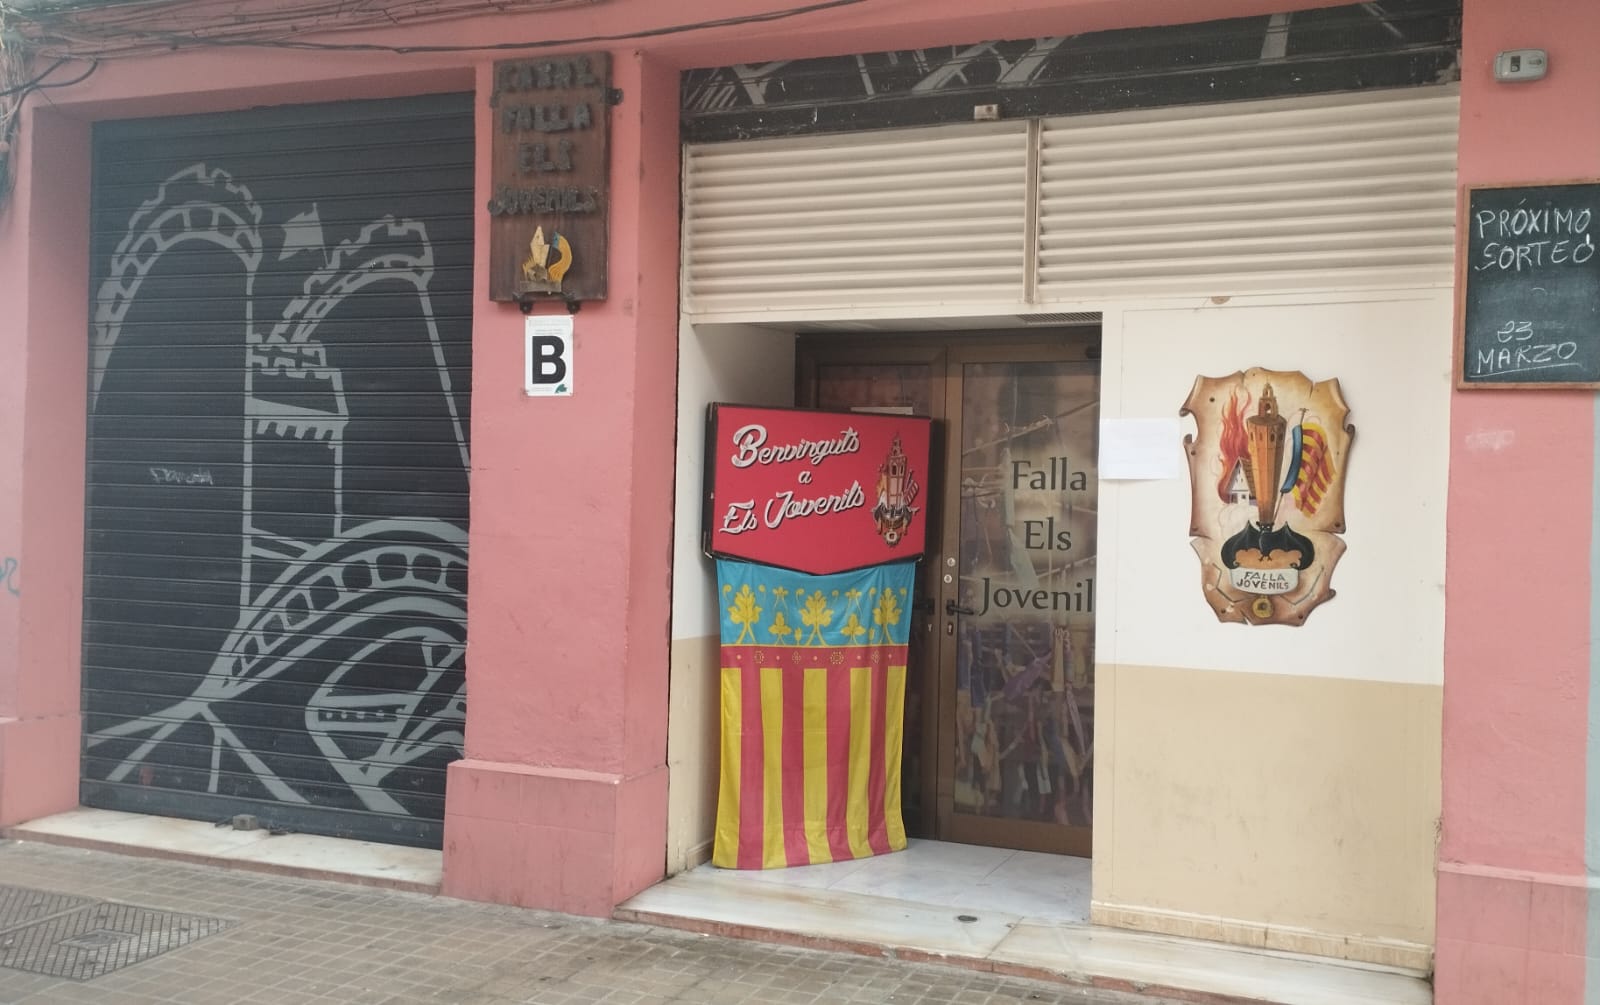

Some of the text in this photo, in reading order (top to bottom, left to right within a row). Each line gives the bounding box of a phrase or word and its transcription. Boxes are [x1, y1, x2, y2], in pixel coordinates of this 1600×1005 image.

[502, 102, 592, 133] FALLA
[518, 138, 572, 173] ELS
[1476, 198, 1591, 239] PRÓXIMO
[1497, 321, 1534, 343] 23
[532, 335, 566, 385] B
[1477, 342, 1577, 373] MARZO
[731, 424, 860, 467] Benvinguts
[798, 470, 812, 484] a
[1011, 457, 1087, 491] Falla
[719, 480, 865, 534] Els Jovenils
[1024, 517, 1072, 551] Els
[1236, 579, 1290, 590] JOVENILS
[1243, 571, 1286, 581] FALLA
